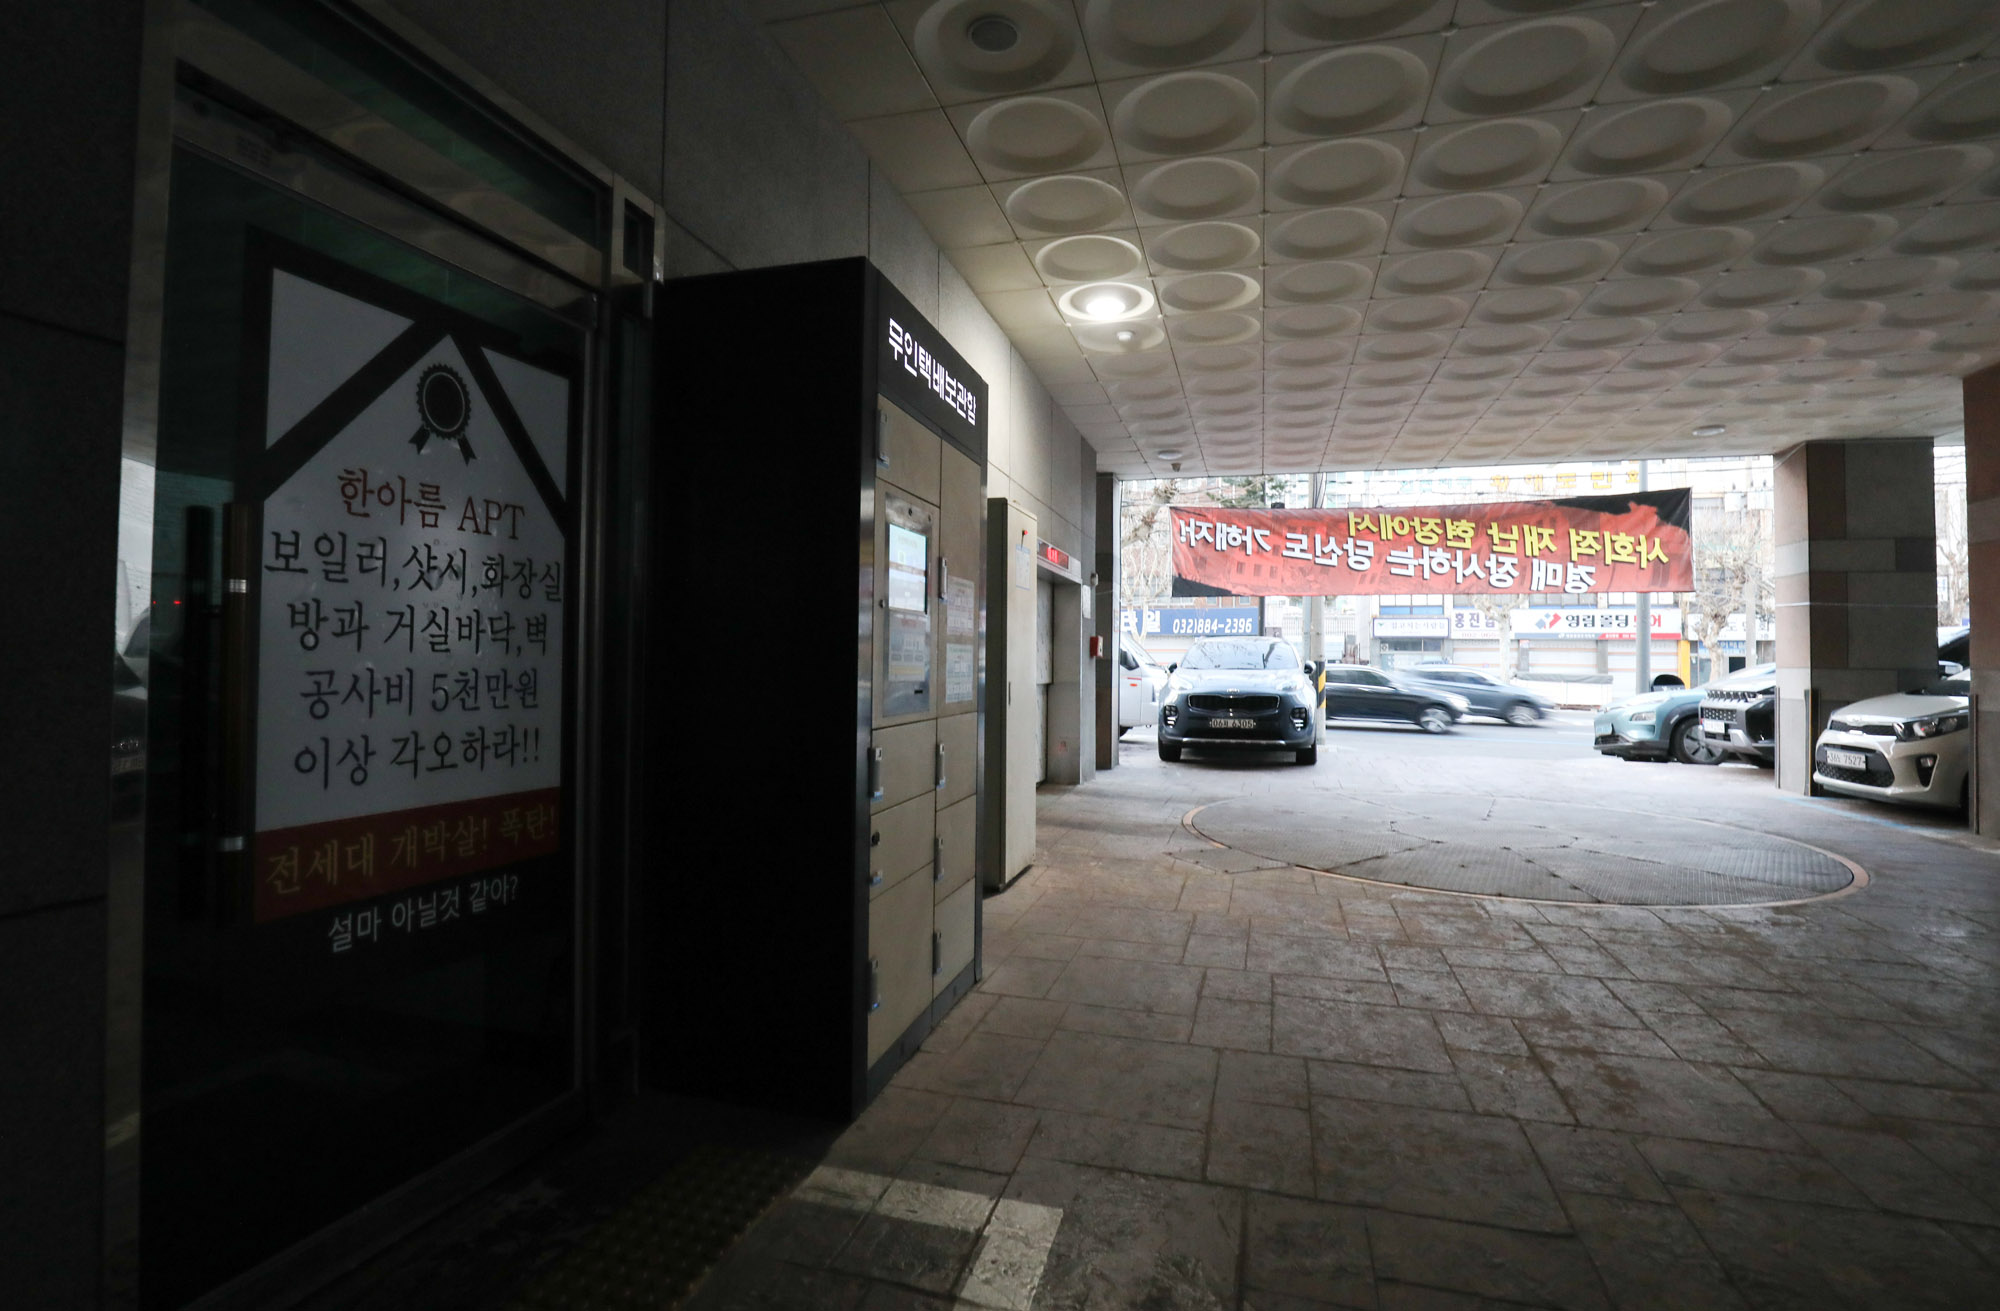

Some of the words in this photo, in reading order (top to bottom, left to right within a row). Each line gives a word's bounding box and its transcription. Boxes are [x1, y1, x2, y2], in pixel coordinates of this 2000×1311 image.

[889, 318, 976, 426] 무인택배보관함
[337, 468, 446, 529] 한아름
[457, 496, 525, 541] APT
[287, 598, 370, 653] 방과
[384, 604, 548, 657] 거실바닥,벽
[1172, 618, 1253, 634] 032)884-2396
[300, 667, 414, 720] 공사비
[431, 667, 539, 712] 5천만원
[294, 735, 377, 790] 이상
[390, 724, 540, 780] 각오하라!!
[1843, 753, 1863, 766] 7527
[265, 832, 376, 895] 전세대
[390, 815, 488, 870] 개박살!
[499, 803, 557, 846] 폭탄!
[328, 906, 382, 953] 설마
[391, 886, 460, 934] 아닐것
[469, 873, 520, 914] 같아?
